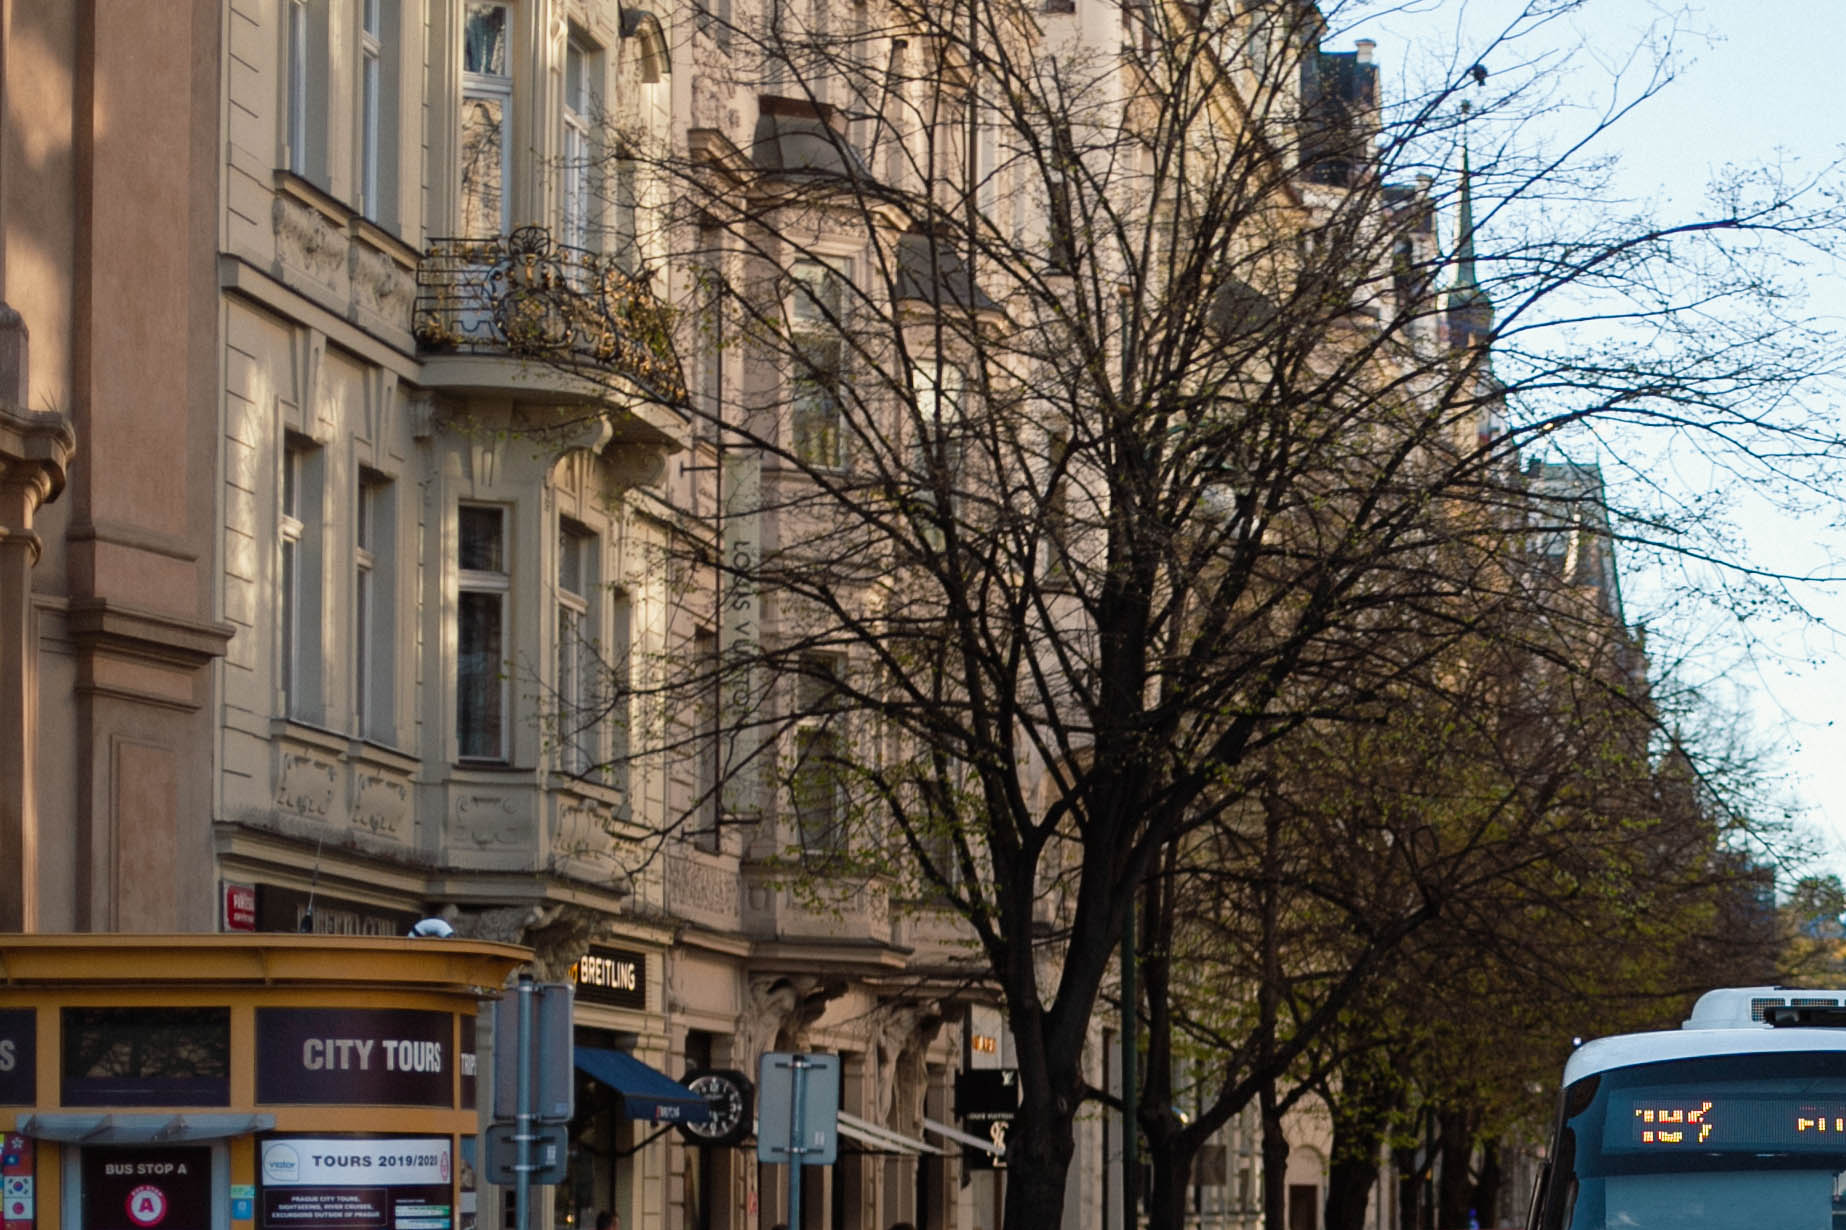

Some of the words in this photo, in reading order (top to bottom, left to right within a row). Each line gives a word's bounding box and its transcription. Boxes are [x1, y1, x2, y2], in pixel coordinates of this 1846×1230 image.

[580, 955, 636, 991] BREITLING
[303, 1038, 374, 1070] CITY
[382, 1040, 441, 1073] TOURS
[312, 1155, 373, 1168] TOURS
[105, 1164, 134, 1175] BUS
[137, 1164, 174, 1175] STOP
[177, 1164, 188, 1175] A
[138, 1198, 155, 1213] A
